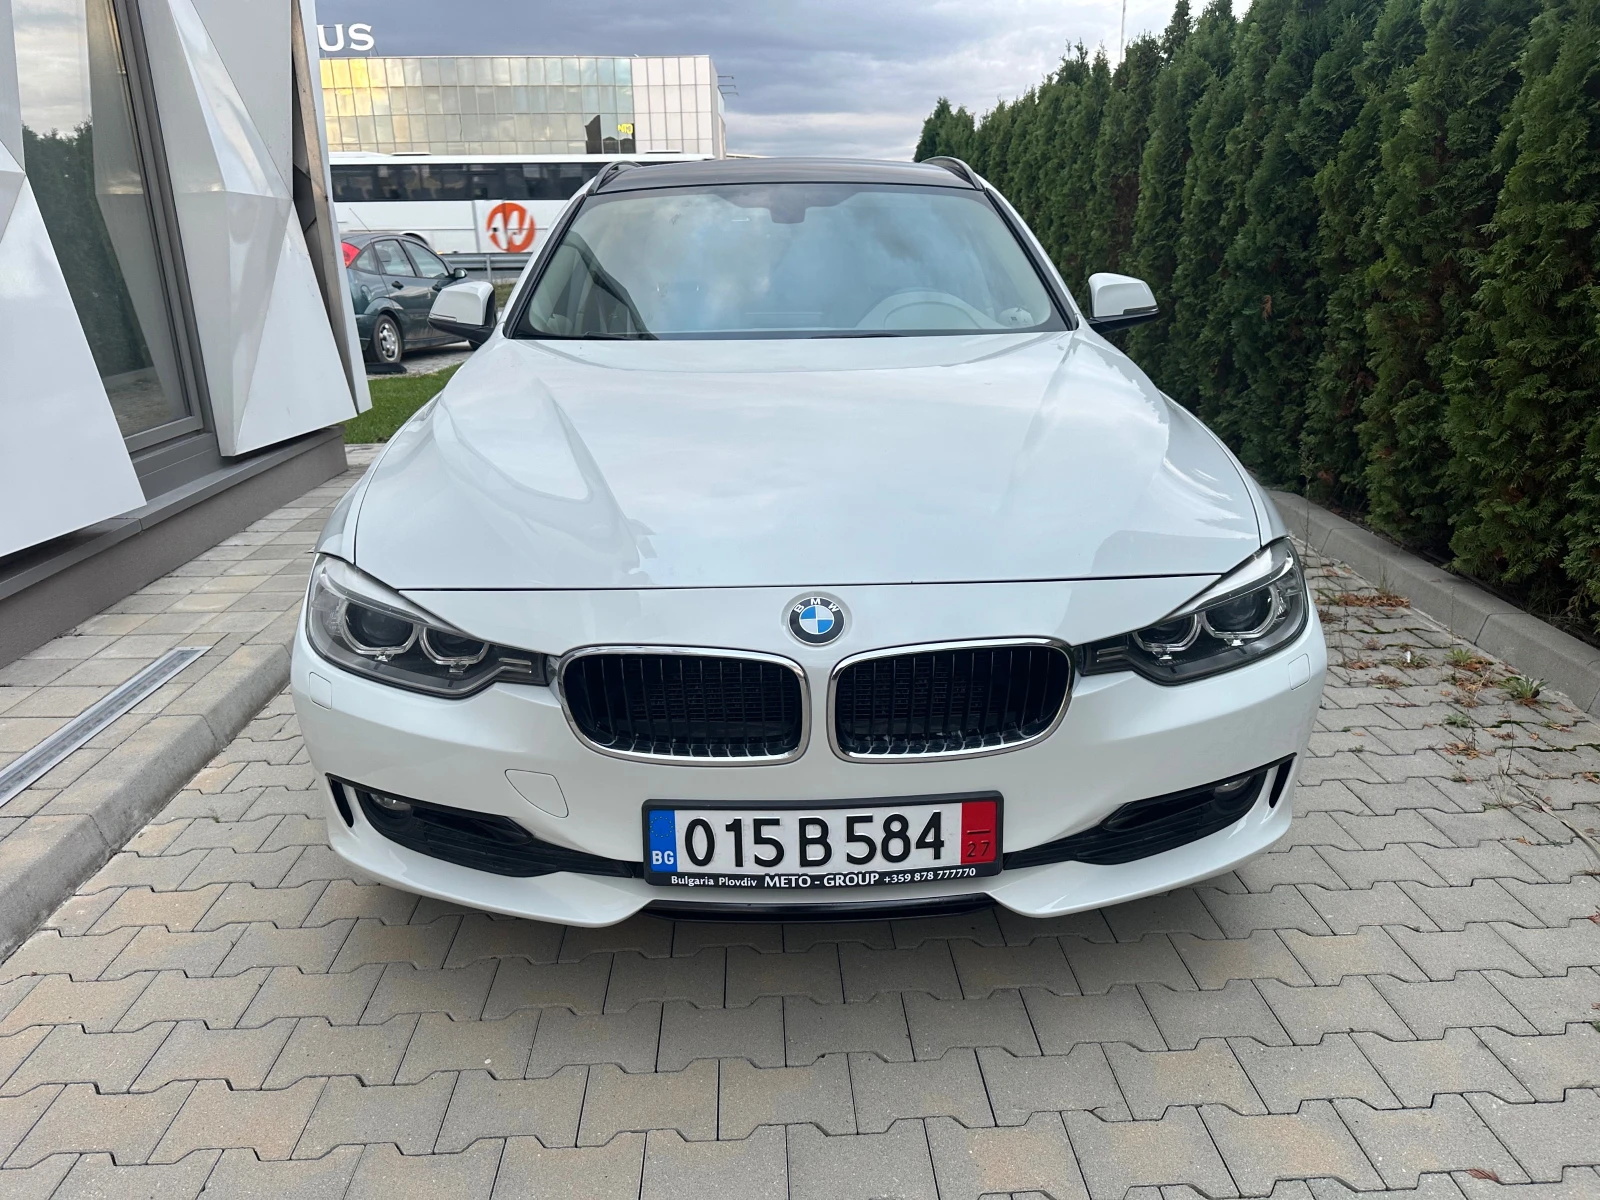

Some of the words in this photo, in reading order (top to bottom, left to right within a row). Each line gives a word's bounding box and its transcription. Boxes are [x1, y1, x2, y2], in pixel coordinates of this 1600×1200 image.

[793, 598, 840, 613] BMW
[684, 817, 785, 868] 015
[798, 817, 832, 868] B
[846, 810, 945, 866] 584
[651, 850, 675, 865] BG
[966, 841, 991, 858] 27
[671, 875, 714, 886] Bulgaria
[718, 877, 757, 887] Plovdiv
[764, 875, 811, 888] METO
[823, 873, 879, 887] GROUP
[883, 873, 912, 884] +359
[914, 871, 934, 882] 878
[937, 867, 976, 880] 777770
